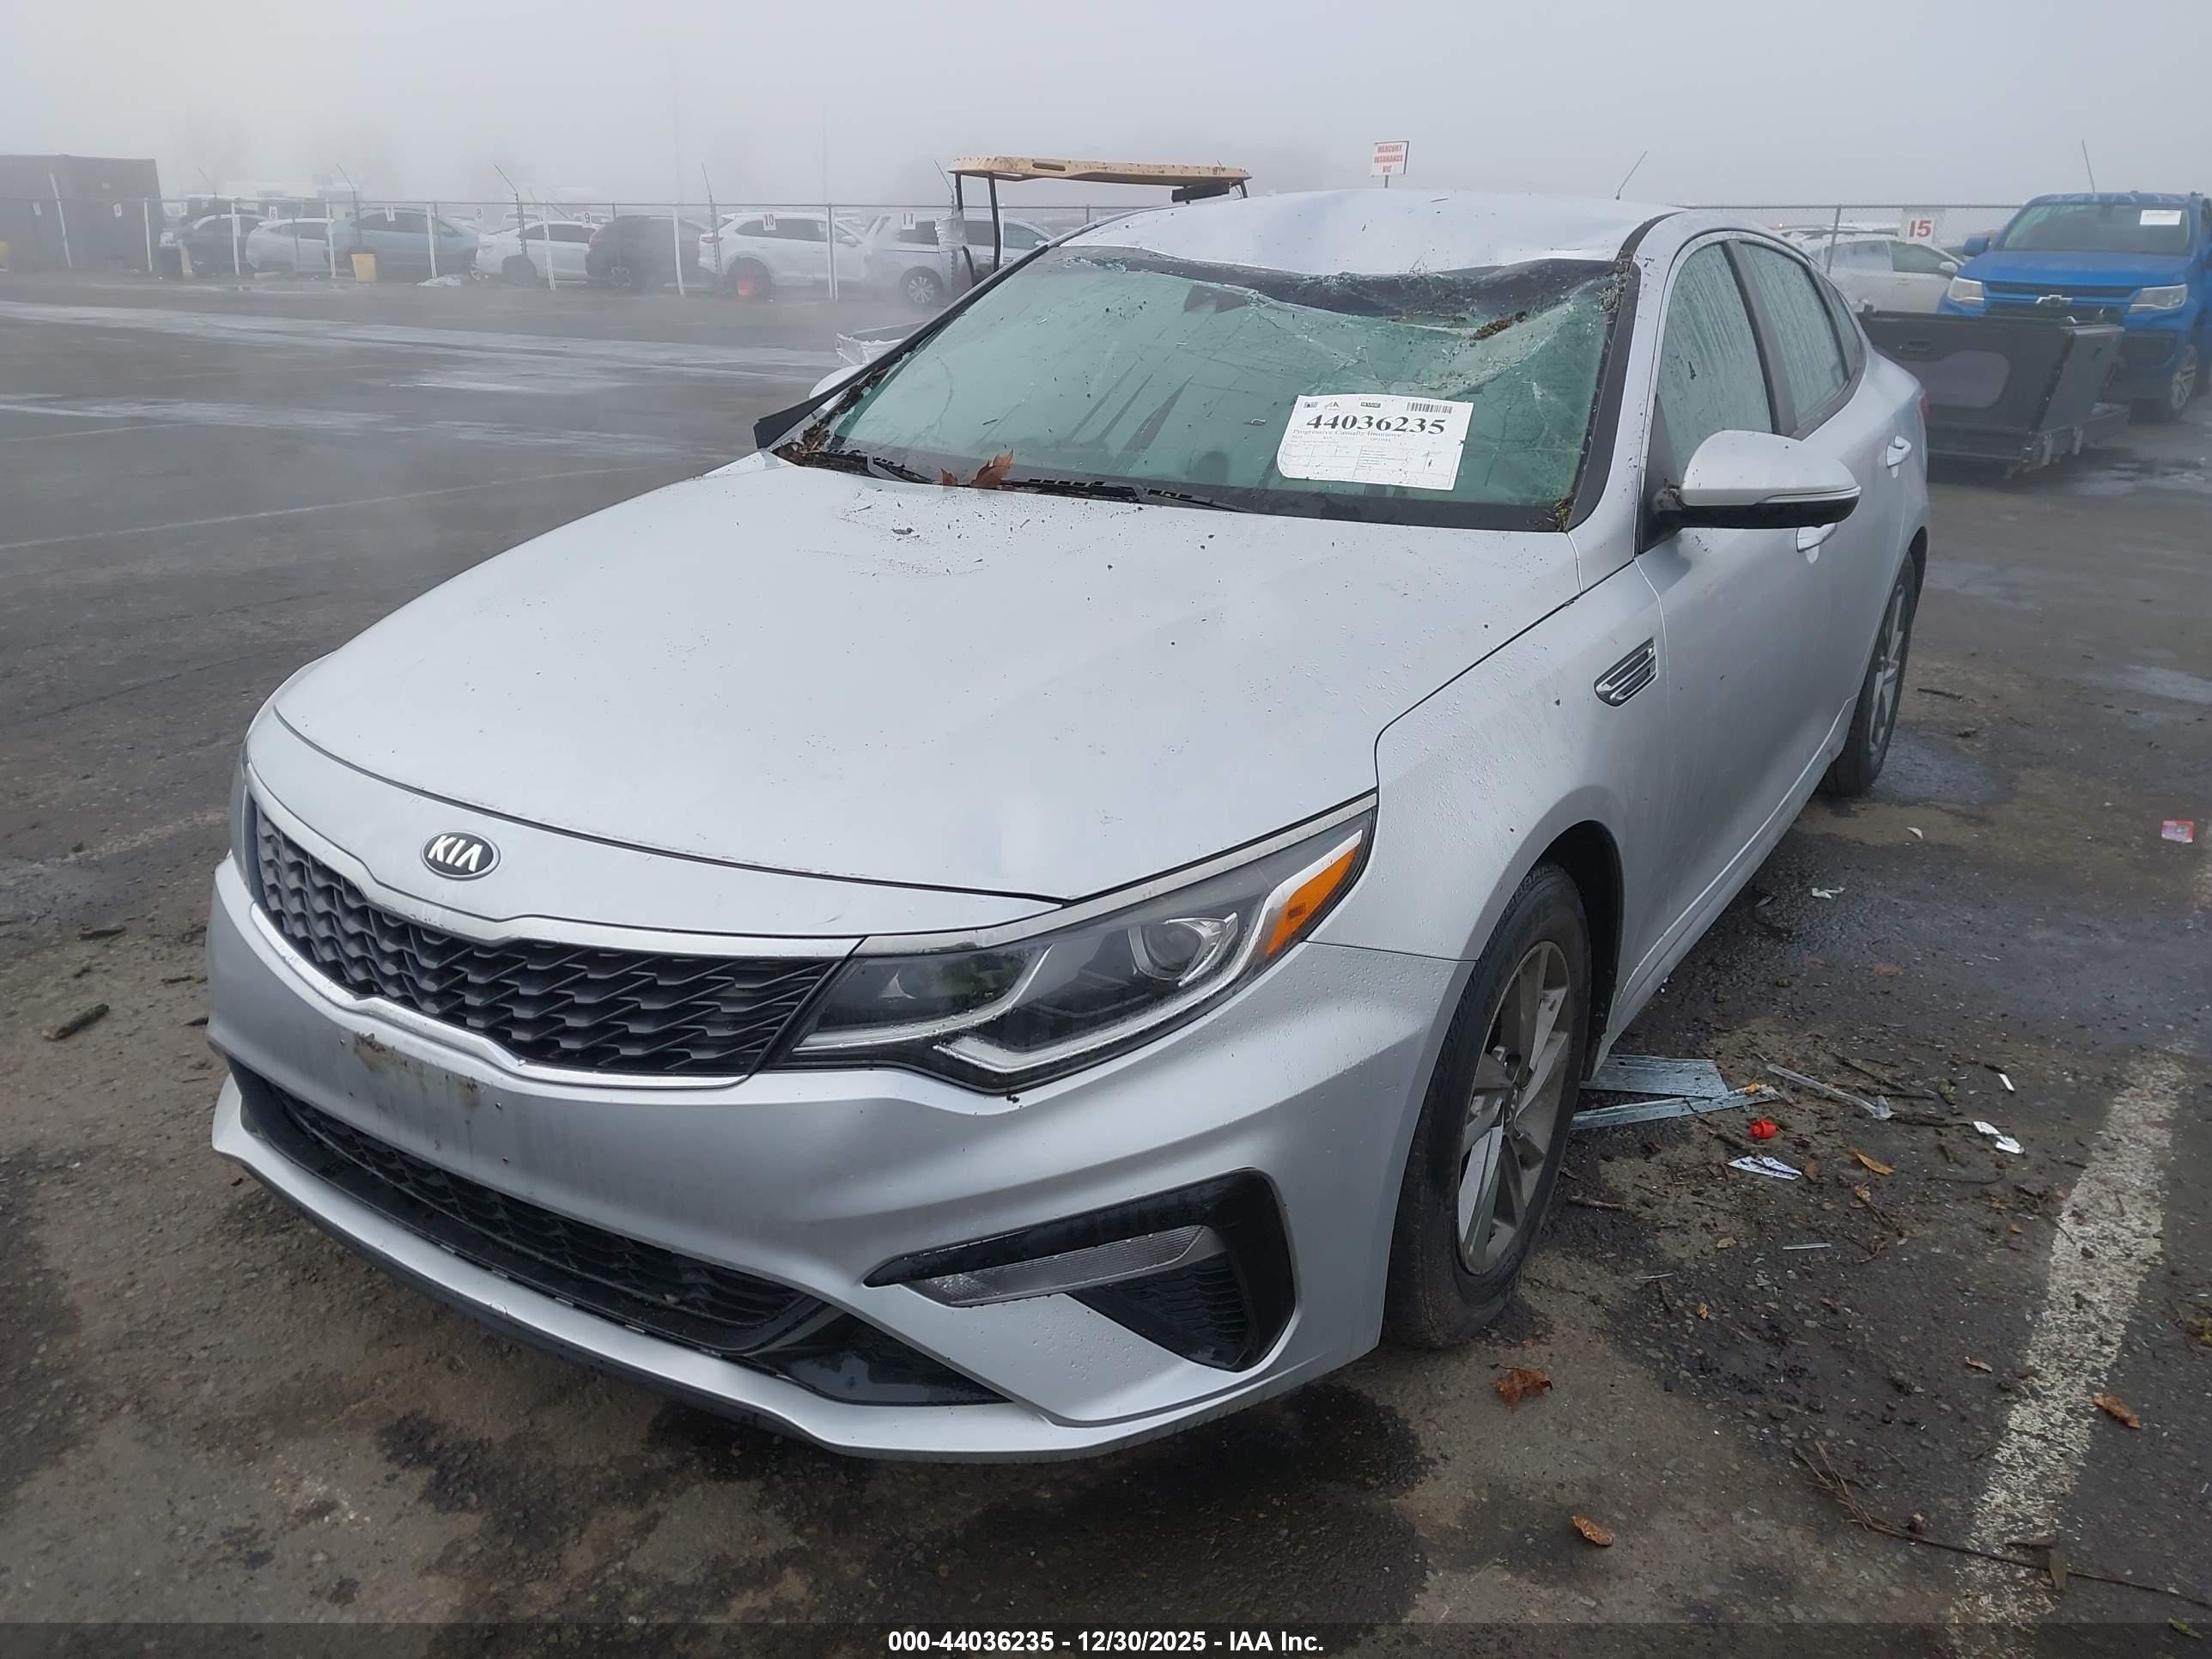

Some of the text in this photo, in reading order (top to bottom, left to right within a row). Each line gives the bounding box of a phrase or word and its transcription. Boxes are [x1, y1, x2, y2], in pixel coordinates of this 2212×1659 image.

[584, 212, 591, 223] 9
[765, 213, 775, 226] 10
[903, 212, 914, 225] 11
[1909, 220, 1932, 238] 15
[1306, 414, 1447, 434] 44036235
[428, 835, 483, 872] KIA
